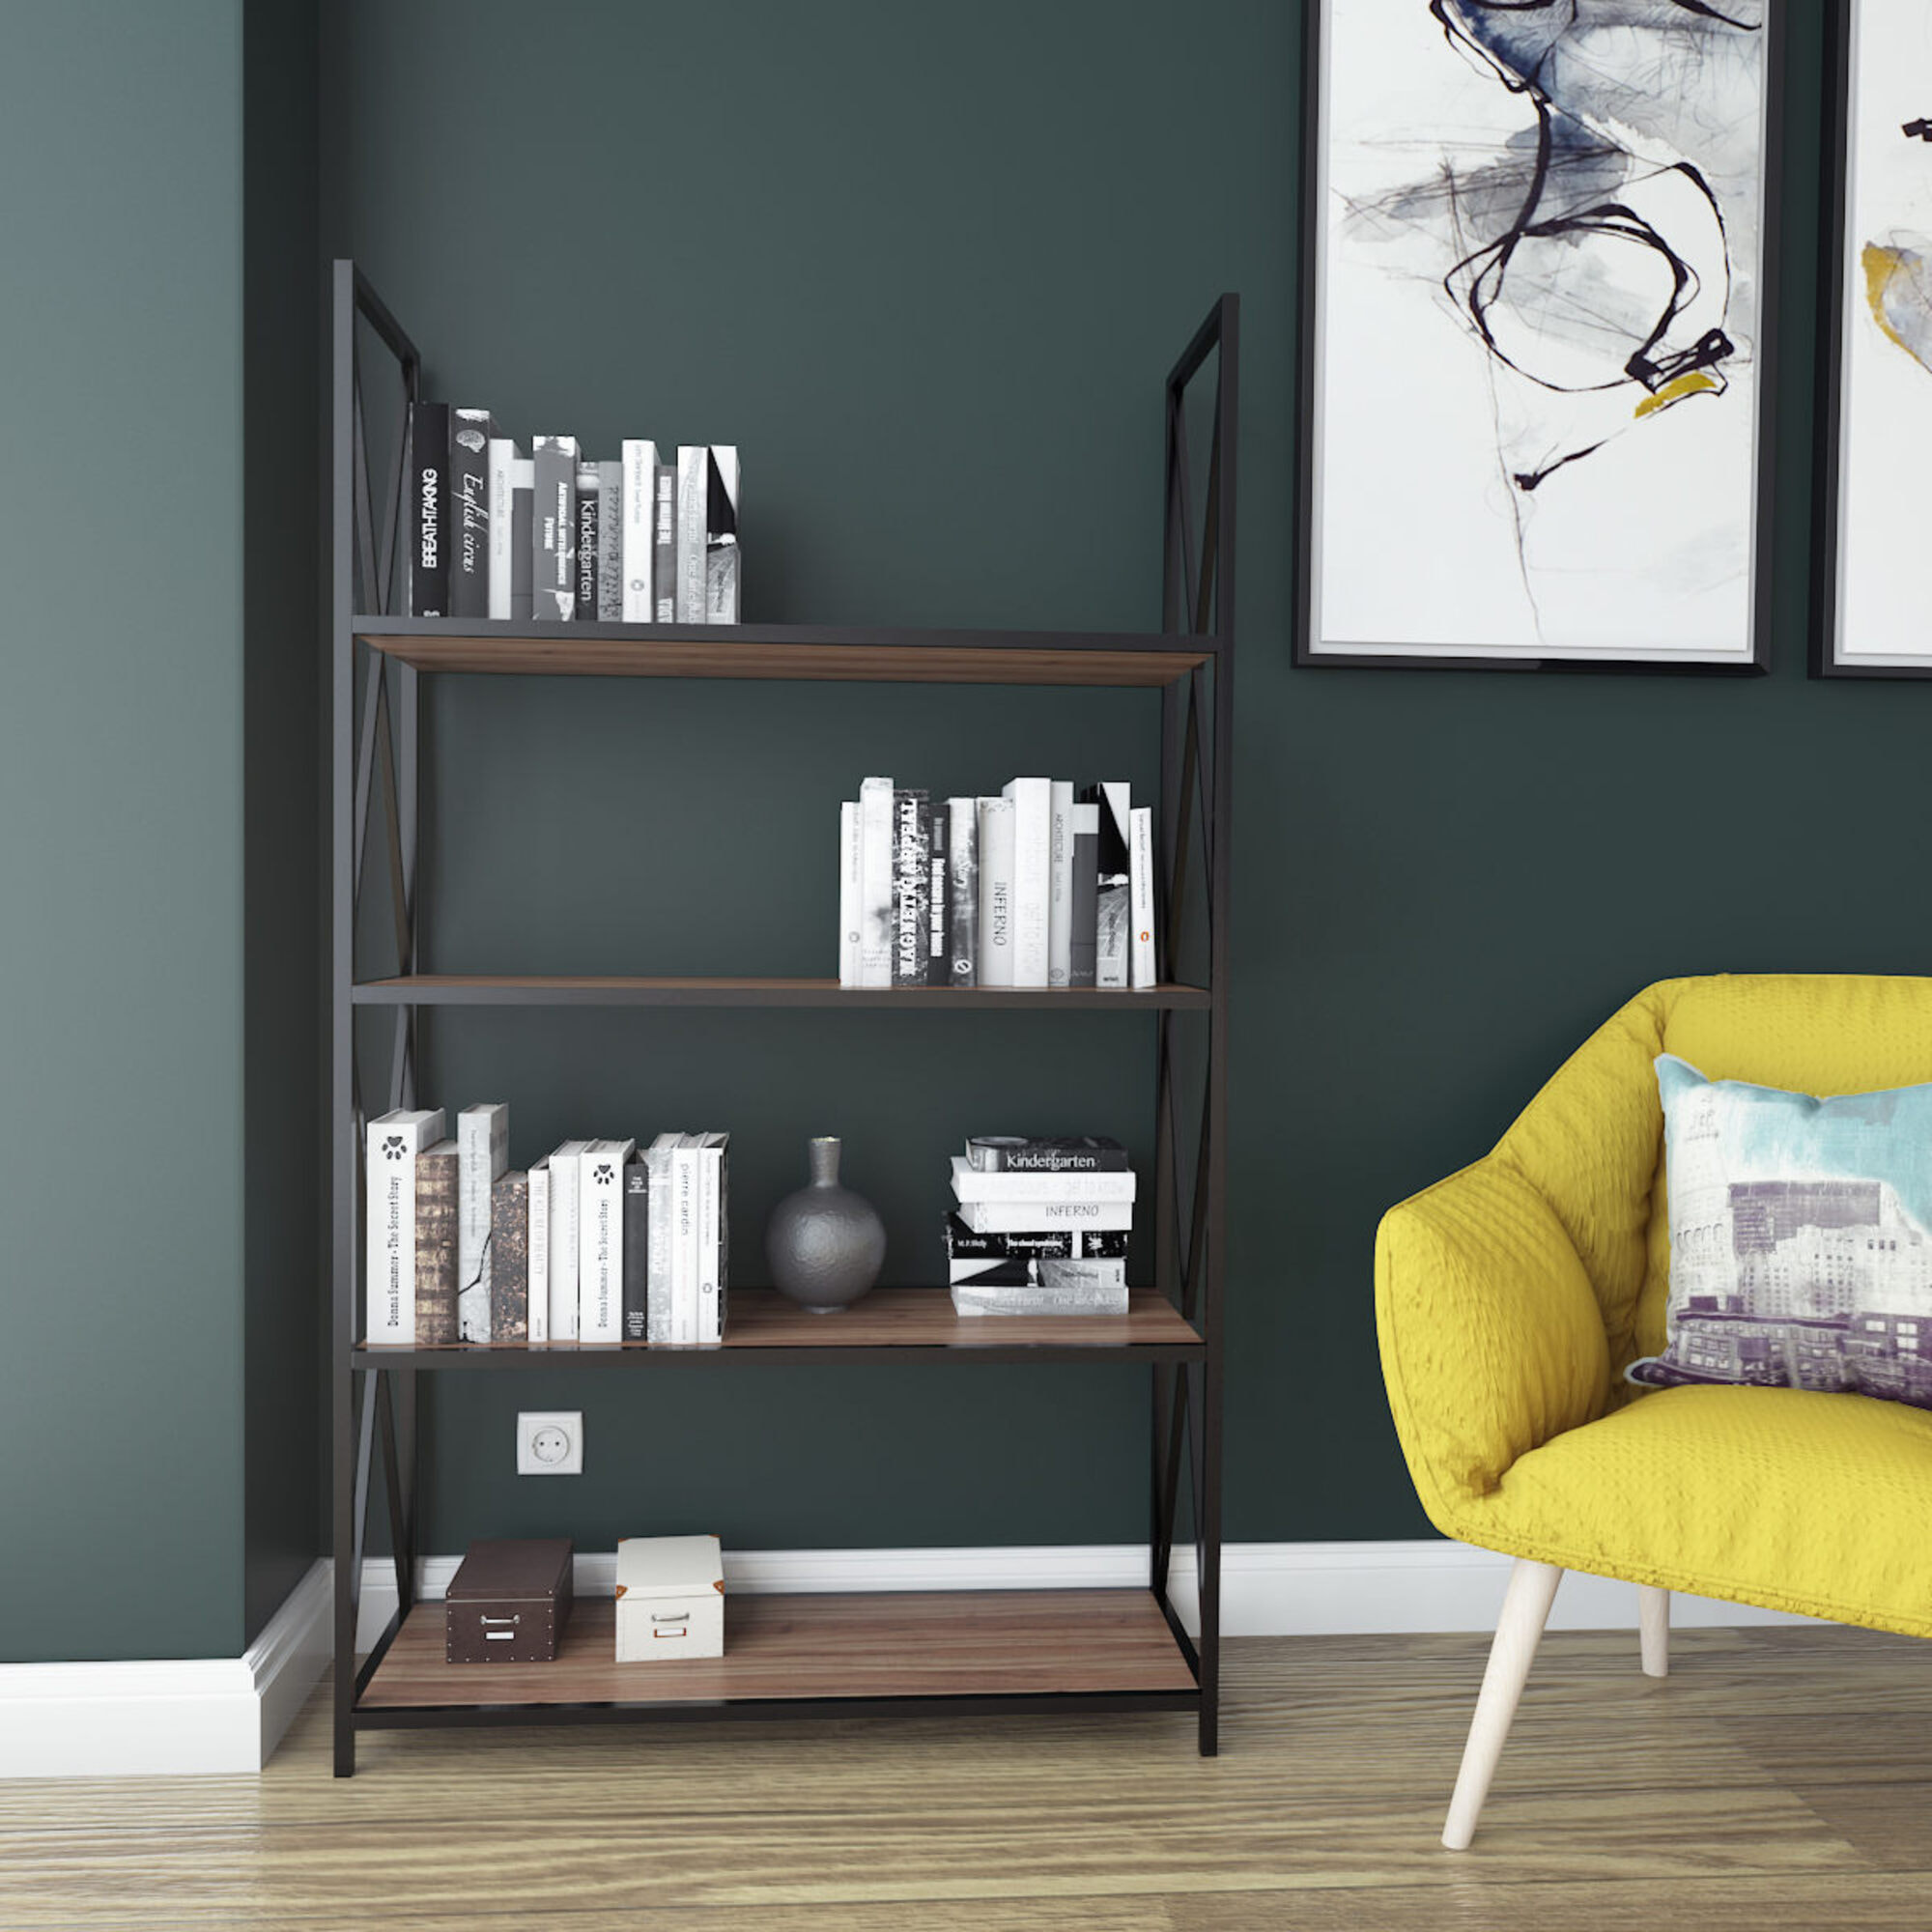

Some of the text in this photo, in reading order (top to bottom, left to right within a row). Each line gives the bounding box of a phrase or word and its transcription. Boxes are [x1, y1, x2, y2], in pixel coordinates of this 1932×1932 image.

[421, 468, 438, 568] BREATHTAKING
[451, 472, 489, 574] English circus
[578, 499, 596, 602] Kindergarten
[993, 881, 1008, 946] INFERNO
[680, 1163, 689, 1198] pierre
[1007, 1153, 1095, 1171] Kindergarten
[1045, 1205, 1099, 1217] INFERNO
[387, 1232, 399, 1249] The
